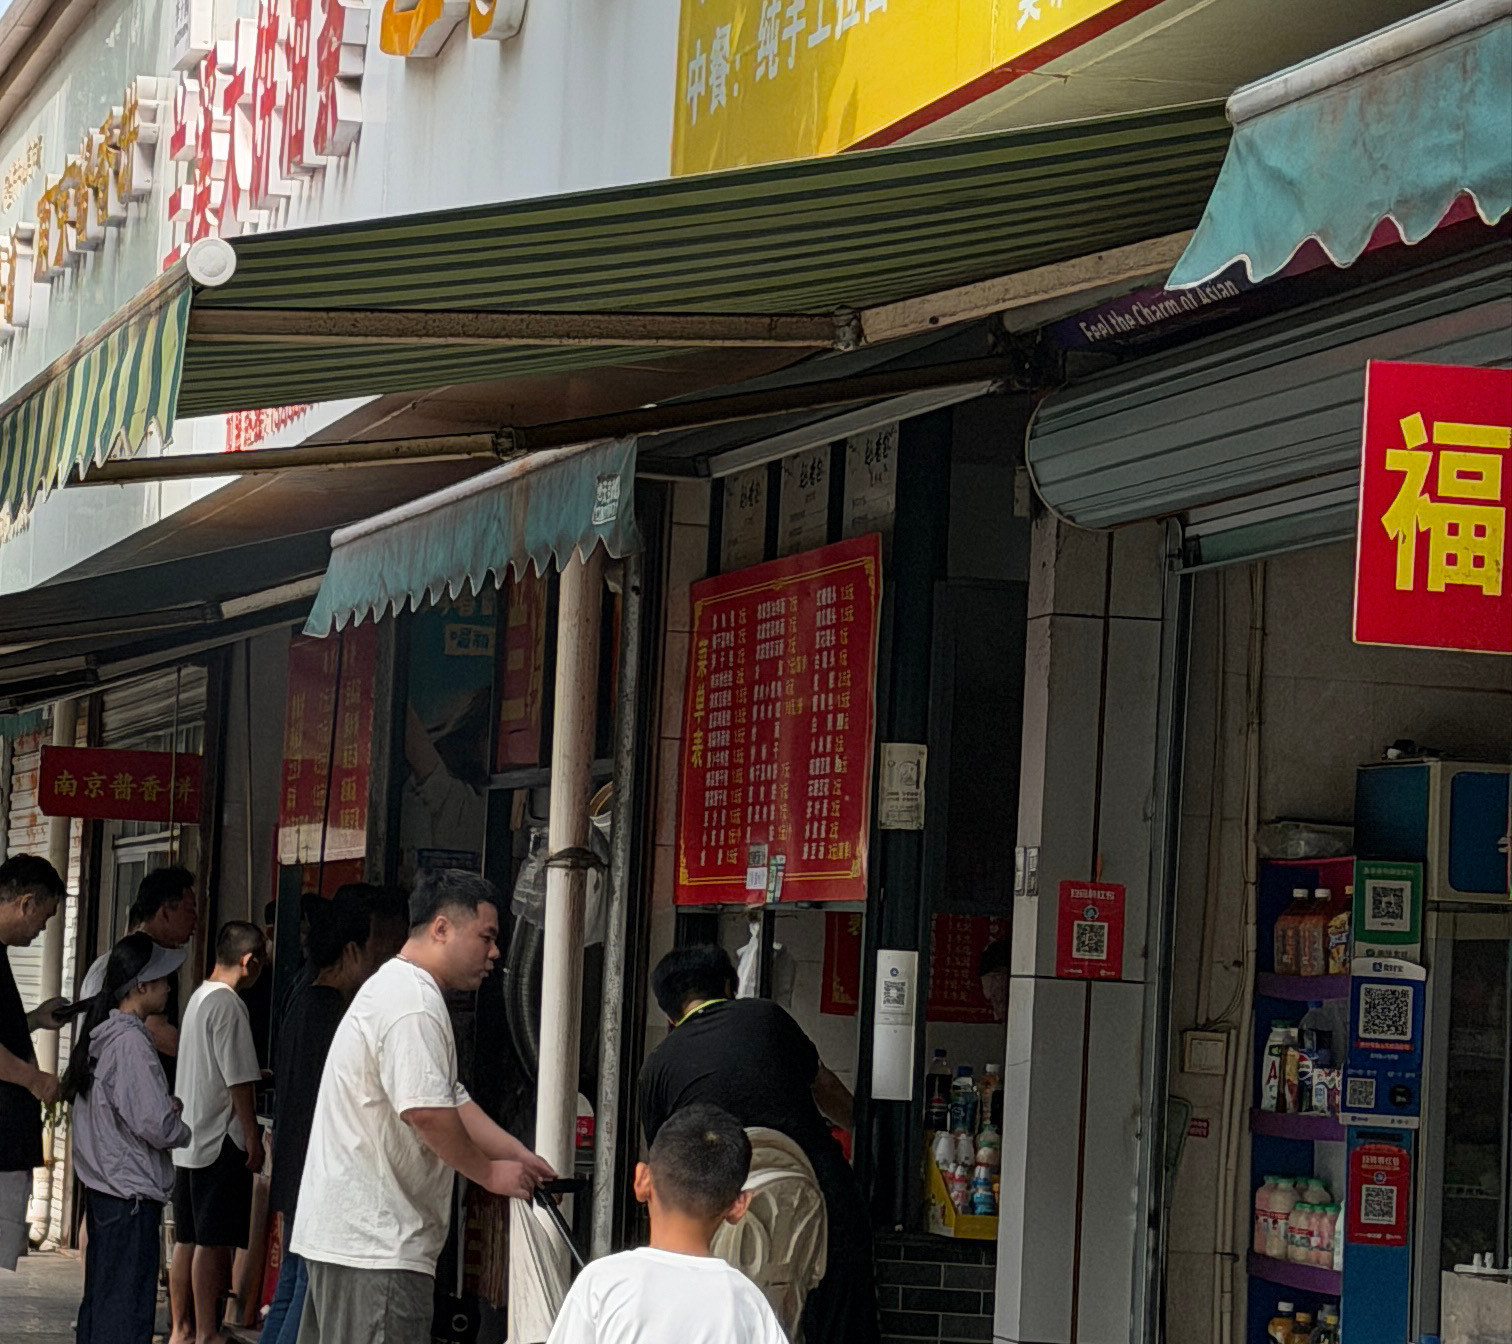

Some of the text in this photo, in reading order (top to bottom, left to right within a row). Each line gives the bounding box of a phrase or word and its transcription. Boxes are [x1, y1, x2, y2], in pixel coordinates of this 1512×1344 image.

[684, 24, 742, 127] 中餐：
[1079, 314, 1114, 342] Feel
[1109, 310, 1136, 333] the
[1132, 297, 1181, 326] Charm
[1382, 412, 1512, 597] 福
